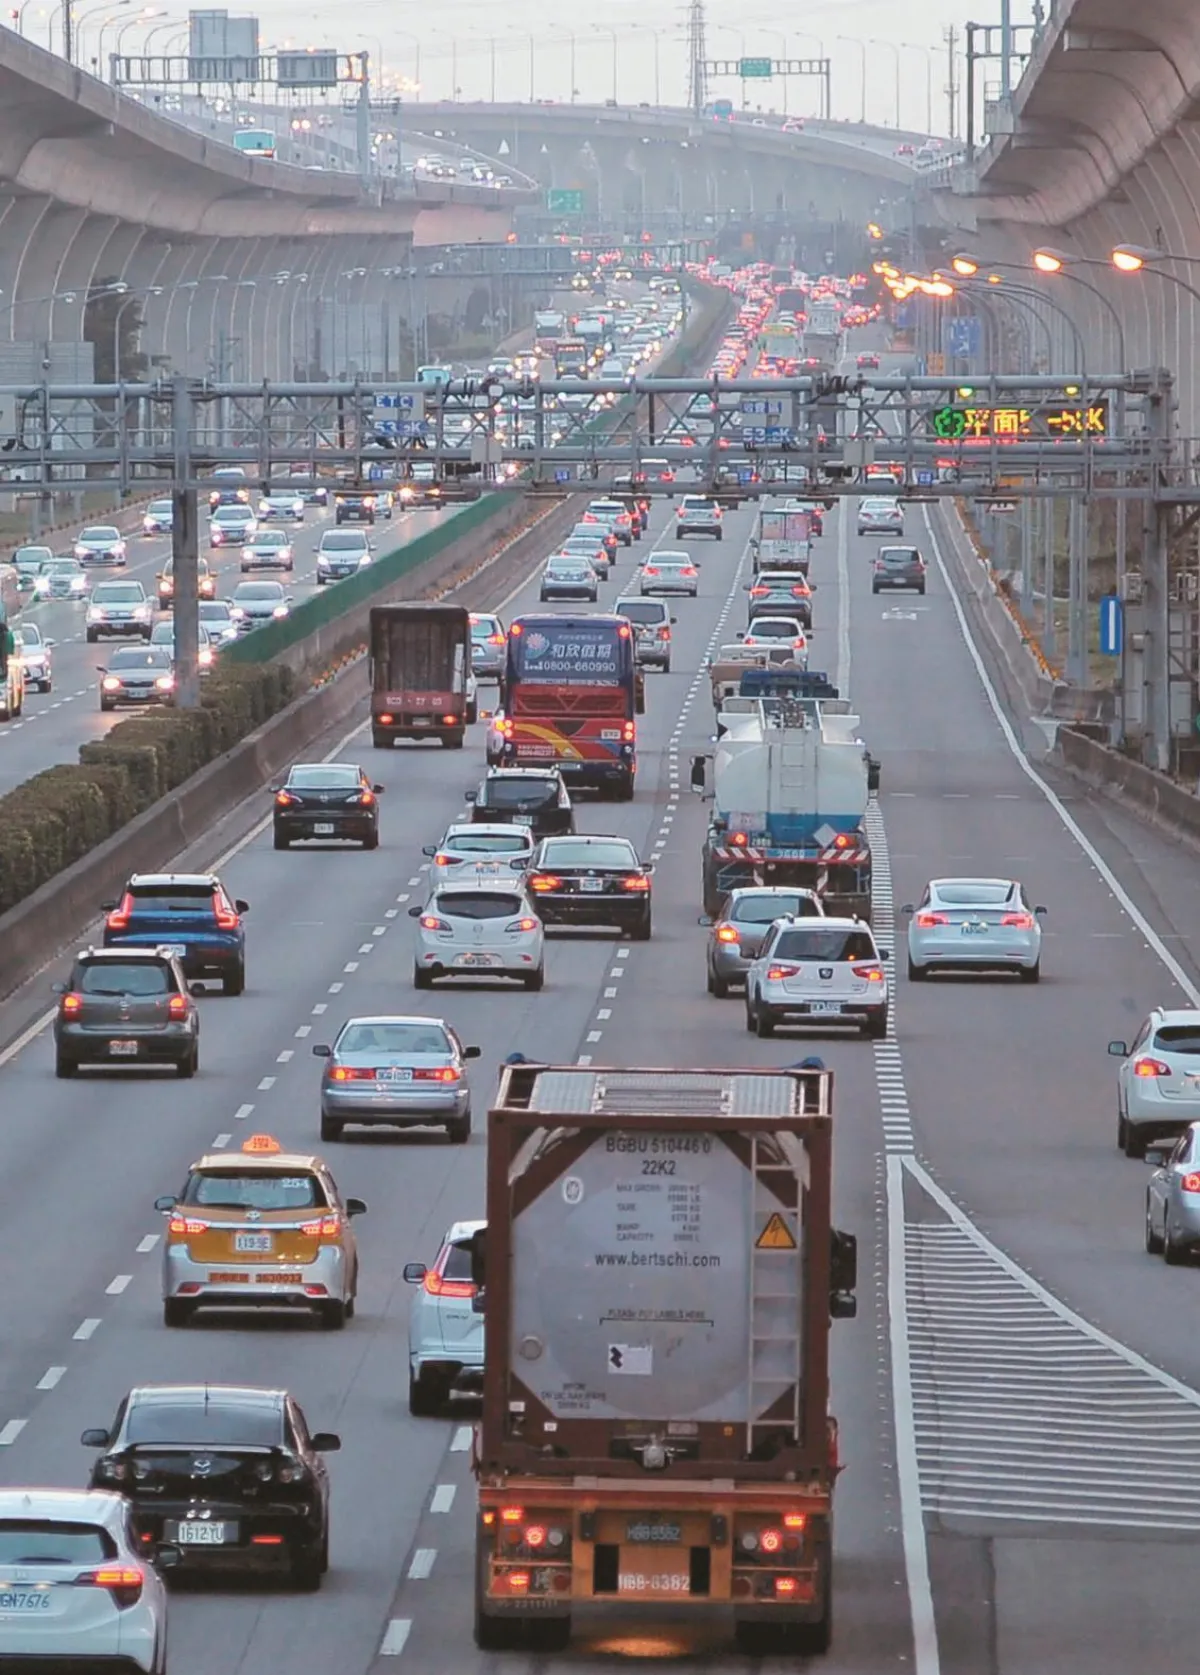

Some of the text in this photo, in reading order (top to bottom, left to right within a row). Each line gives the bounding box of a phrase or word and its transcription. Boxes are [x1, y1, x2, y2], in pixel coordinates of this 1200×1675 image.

[376, 395, 409, 407] ETC
[606, 1137, 648, 1153] BGBU
[642, 1160, 676, 1175] 22K2
[595, 1250, 721, 1267] www.bertschi.com
